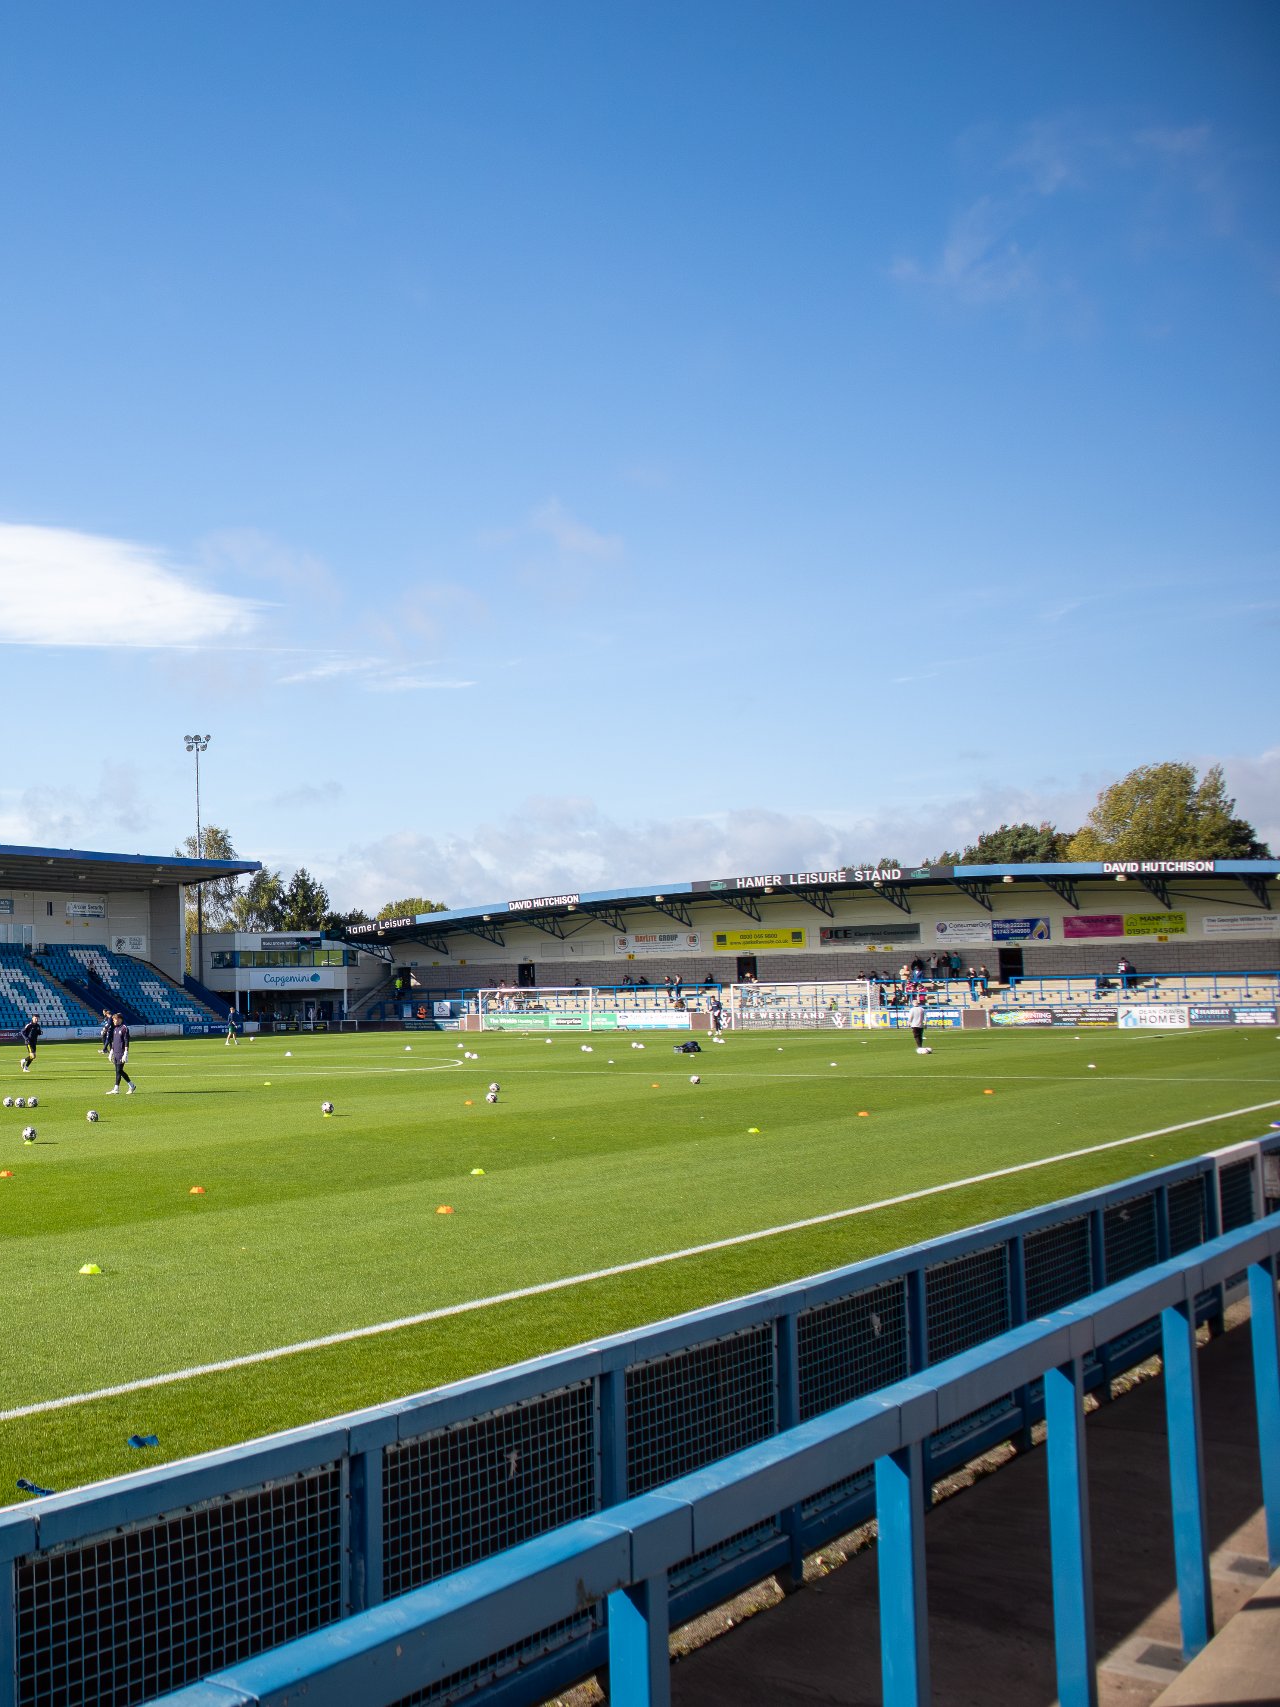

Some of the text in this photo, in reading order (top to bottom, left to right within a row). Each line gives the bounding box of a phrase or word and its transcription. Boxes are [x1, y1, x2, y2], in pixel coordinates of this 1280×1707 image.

[1103, 862, 1214, 872] DAVID HUTCHISON
[737, 869, 902, 888] HAMER LEISURE STAND
[509, 895, 580, 911] DAVID HUTCHISON
[346, 924, 376, 934] Hamer
[826, 930, 852, 940] JCE
[264, 973, 310, 986] Capgemini
[1139, 1015, 1186, 1024] HOMES
